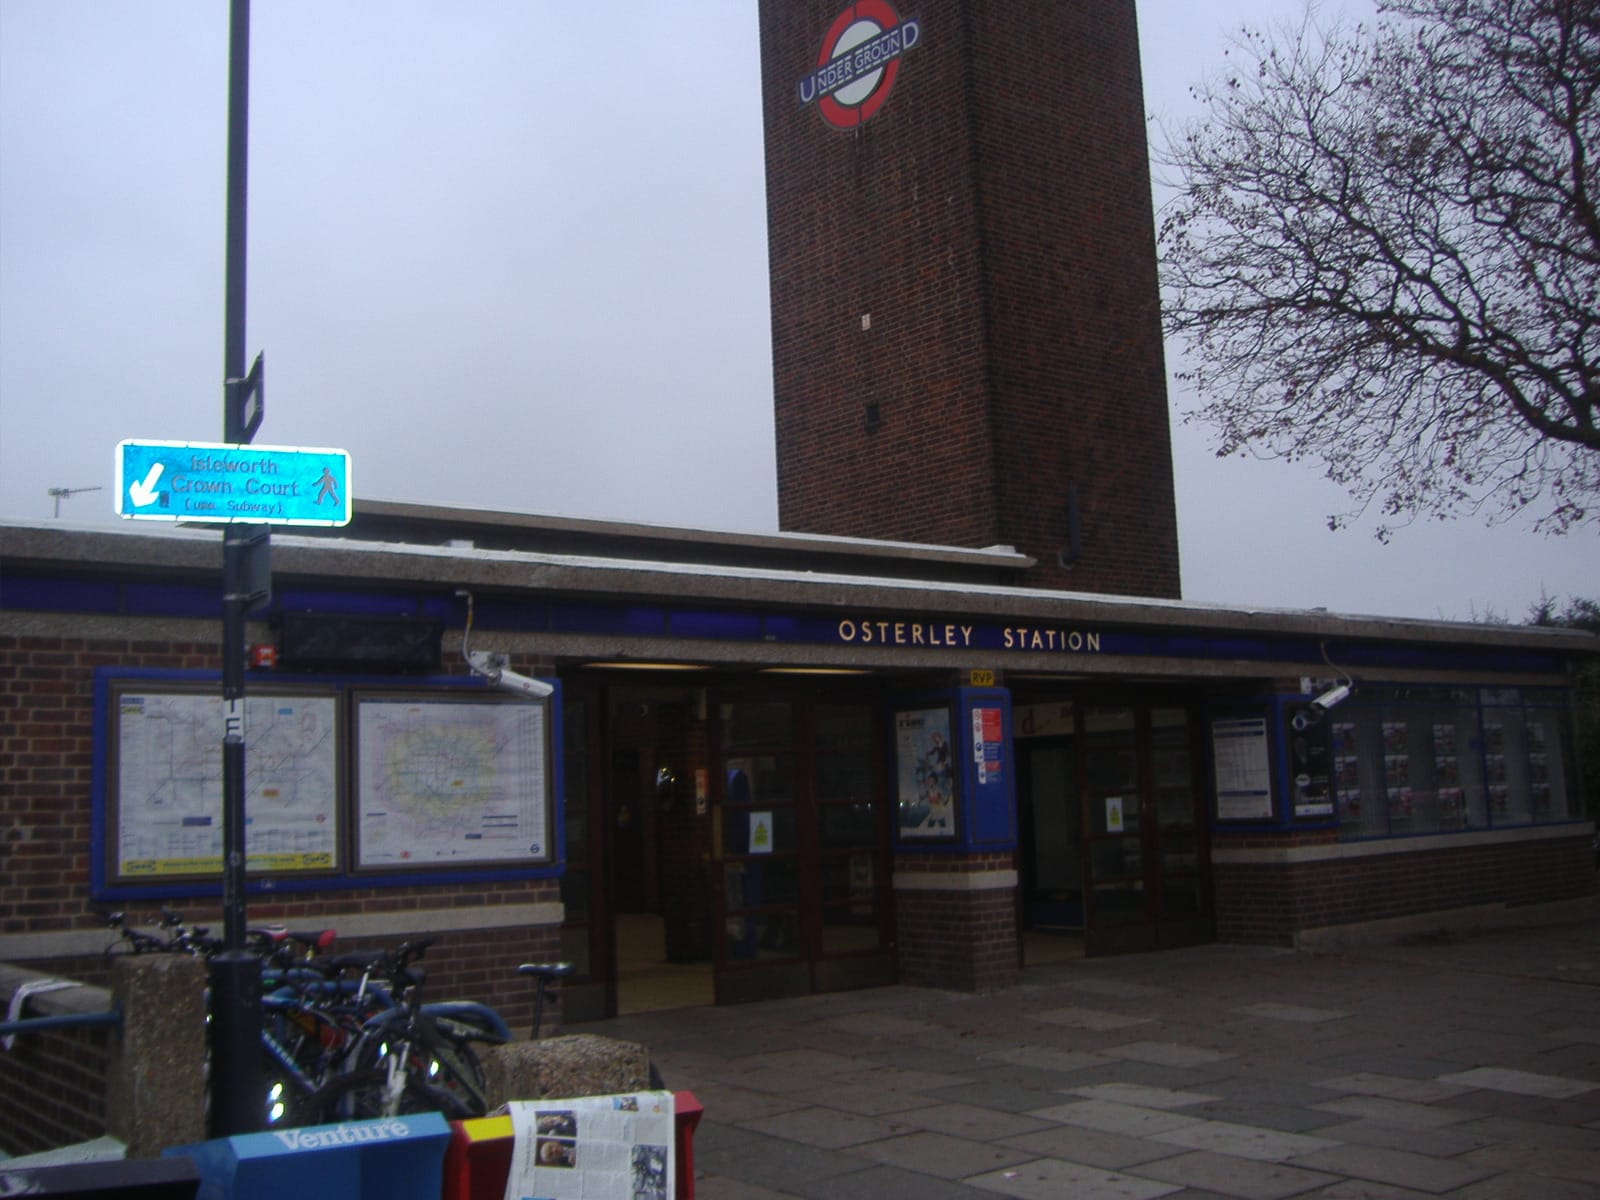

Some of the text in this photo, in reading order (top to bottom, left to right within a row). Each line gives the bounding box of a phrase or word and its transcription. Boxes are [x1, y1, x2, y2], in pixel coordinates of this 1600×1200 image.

[191, 455, 279, 475] Isleworth
[171, 475, 300, 497] Crown Court
[227, 500, 284, 515] Subway)
[838, 619, 1101, 652] OSTERLEY STATION
[274, 1119, 410, 1150] Venture
